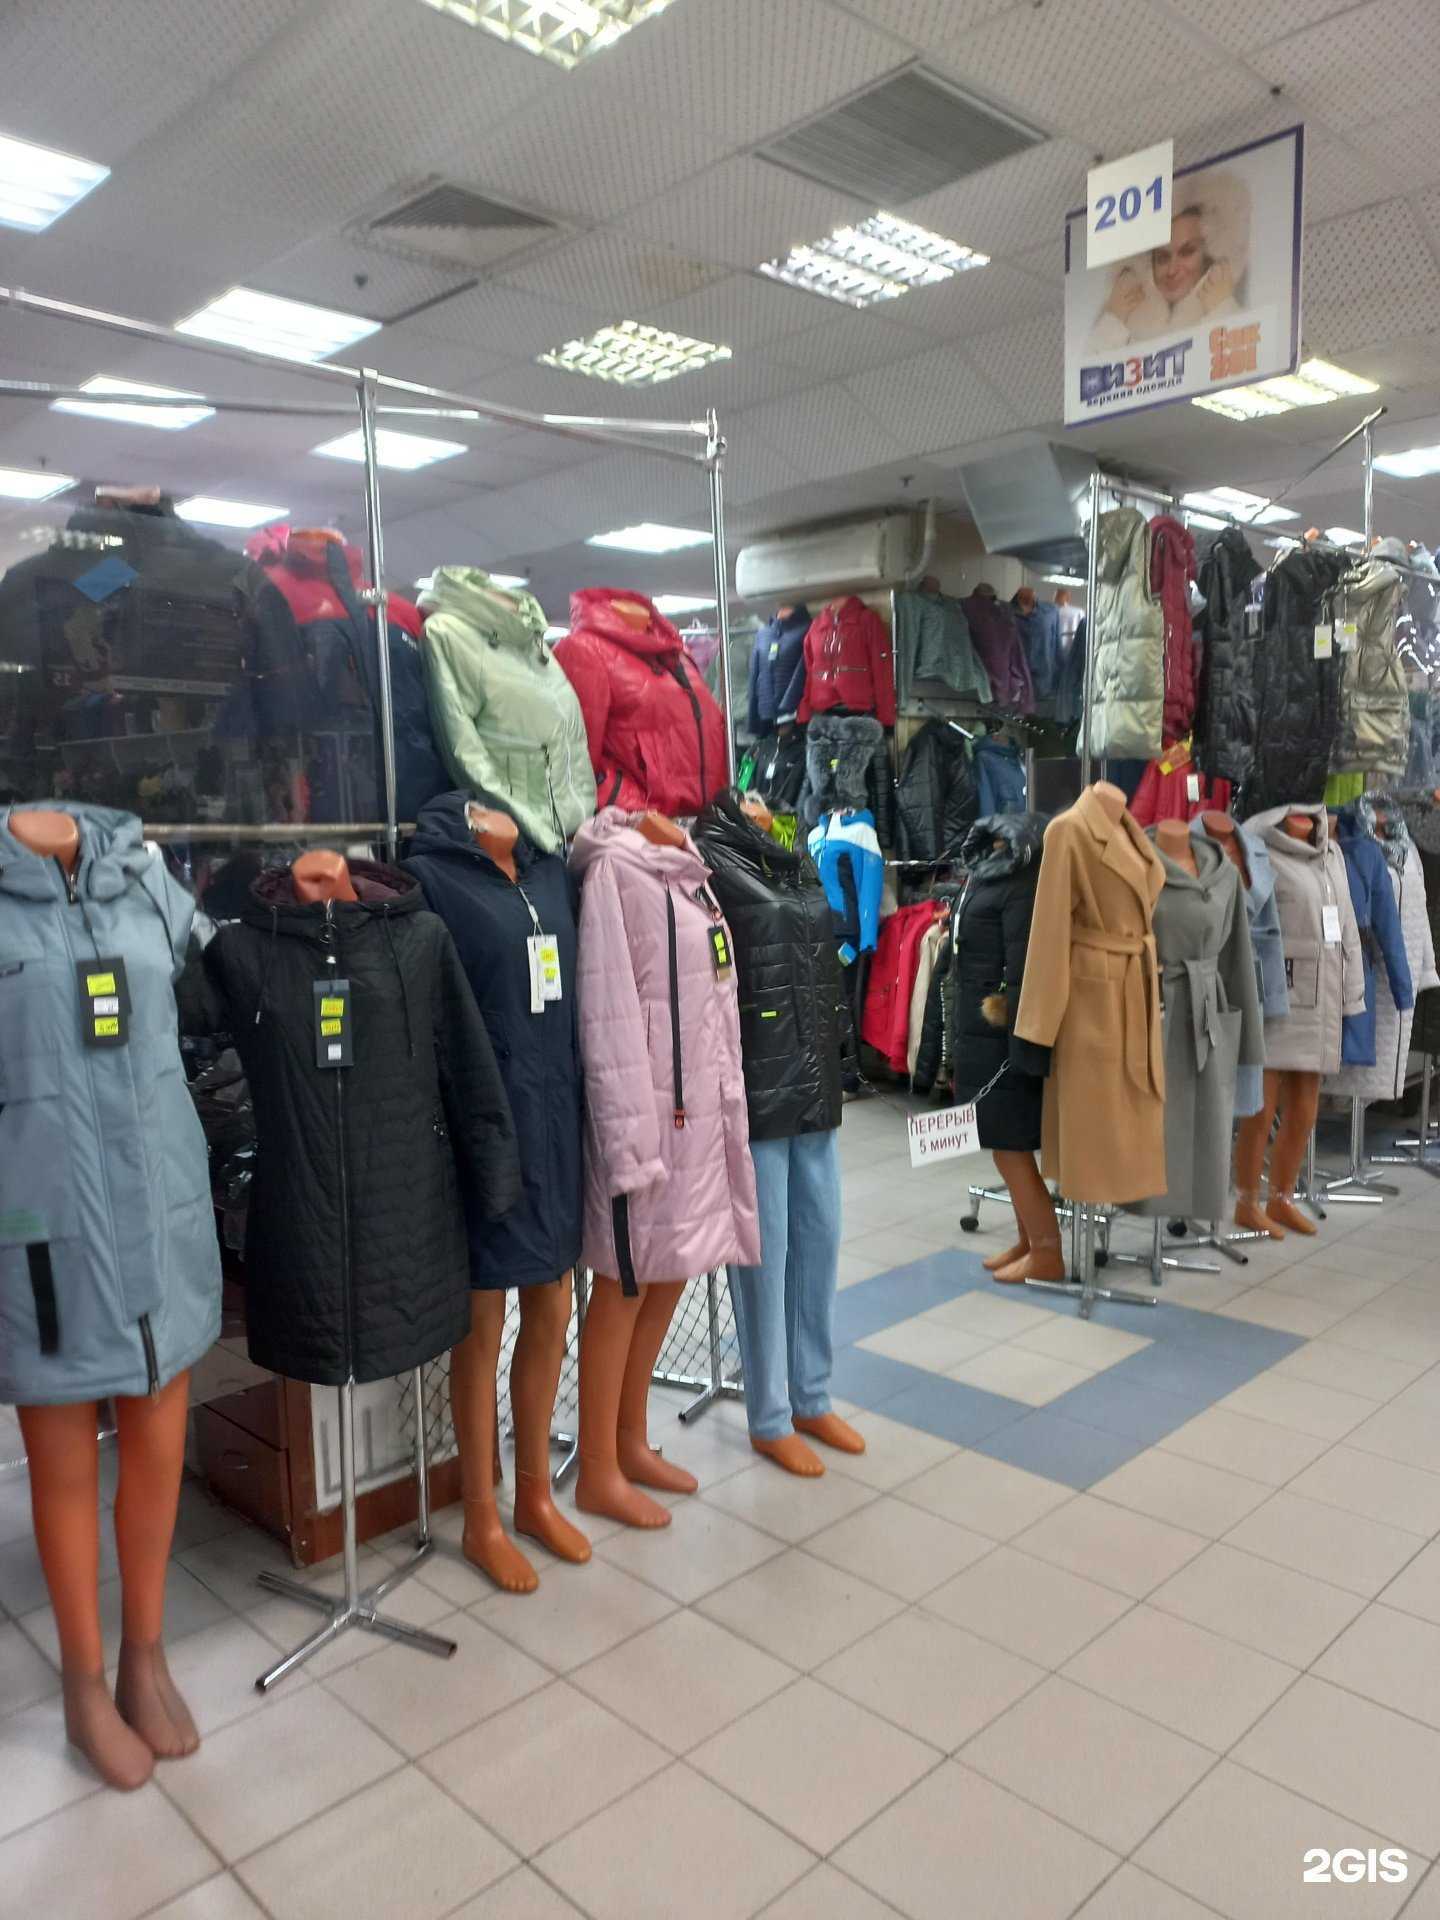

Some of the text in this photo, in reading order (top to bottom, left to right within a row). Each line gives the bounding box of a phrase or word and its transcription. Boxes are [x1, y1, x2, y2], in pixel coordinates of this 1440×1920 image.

[1095, 175, 1163, 232] 201
[910, 1108, 975, 1136] ПЕРЕРЫВ
[919, 1137, 927, 1154] 5
